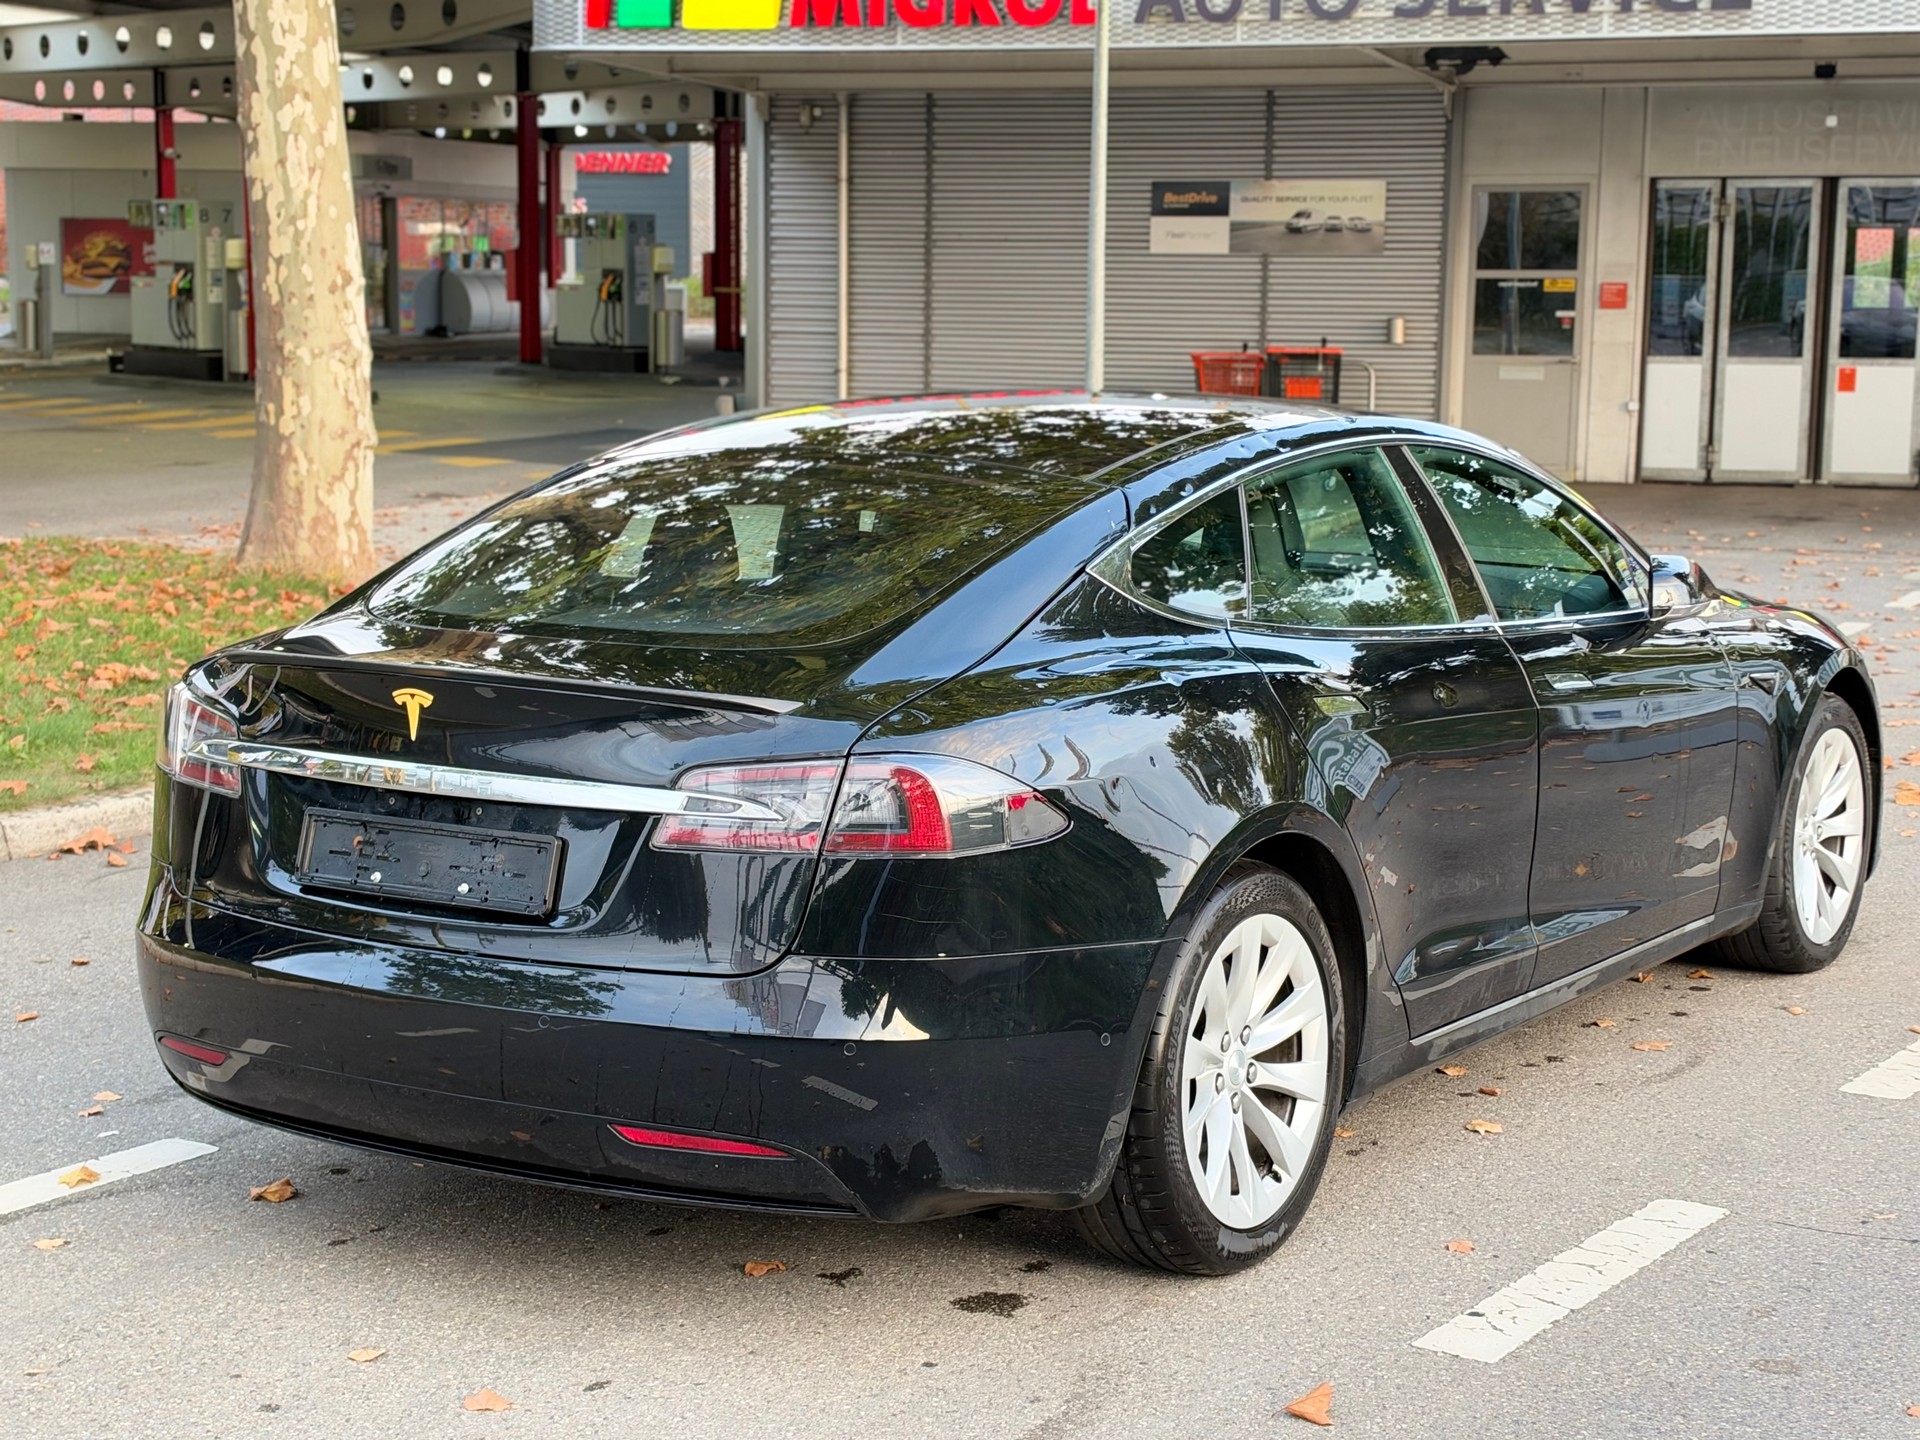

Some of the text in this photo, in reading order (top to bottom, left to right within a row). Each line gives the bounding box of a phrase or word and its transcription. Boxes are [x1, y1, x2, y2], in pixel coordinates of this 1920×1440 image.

[1694, 134, 1920, 168] PNEUSERVI
[1163, 191, 1218, 204] BestDrive
[1241, 195, 1273, 204] QUALITY
[1275, 195, 1307, 204] SERVICE
[1309, 195, 1325, 204] FOR
[1327, 194, 1349, 204] YOUR
[200, 207, 232, 223] 8 7
[1333, 737, 1369, 780] Rabatt
[341, 763, 492, 795] TESLA
